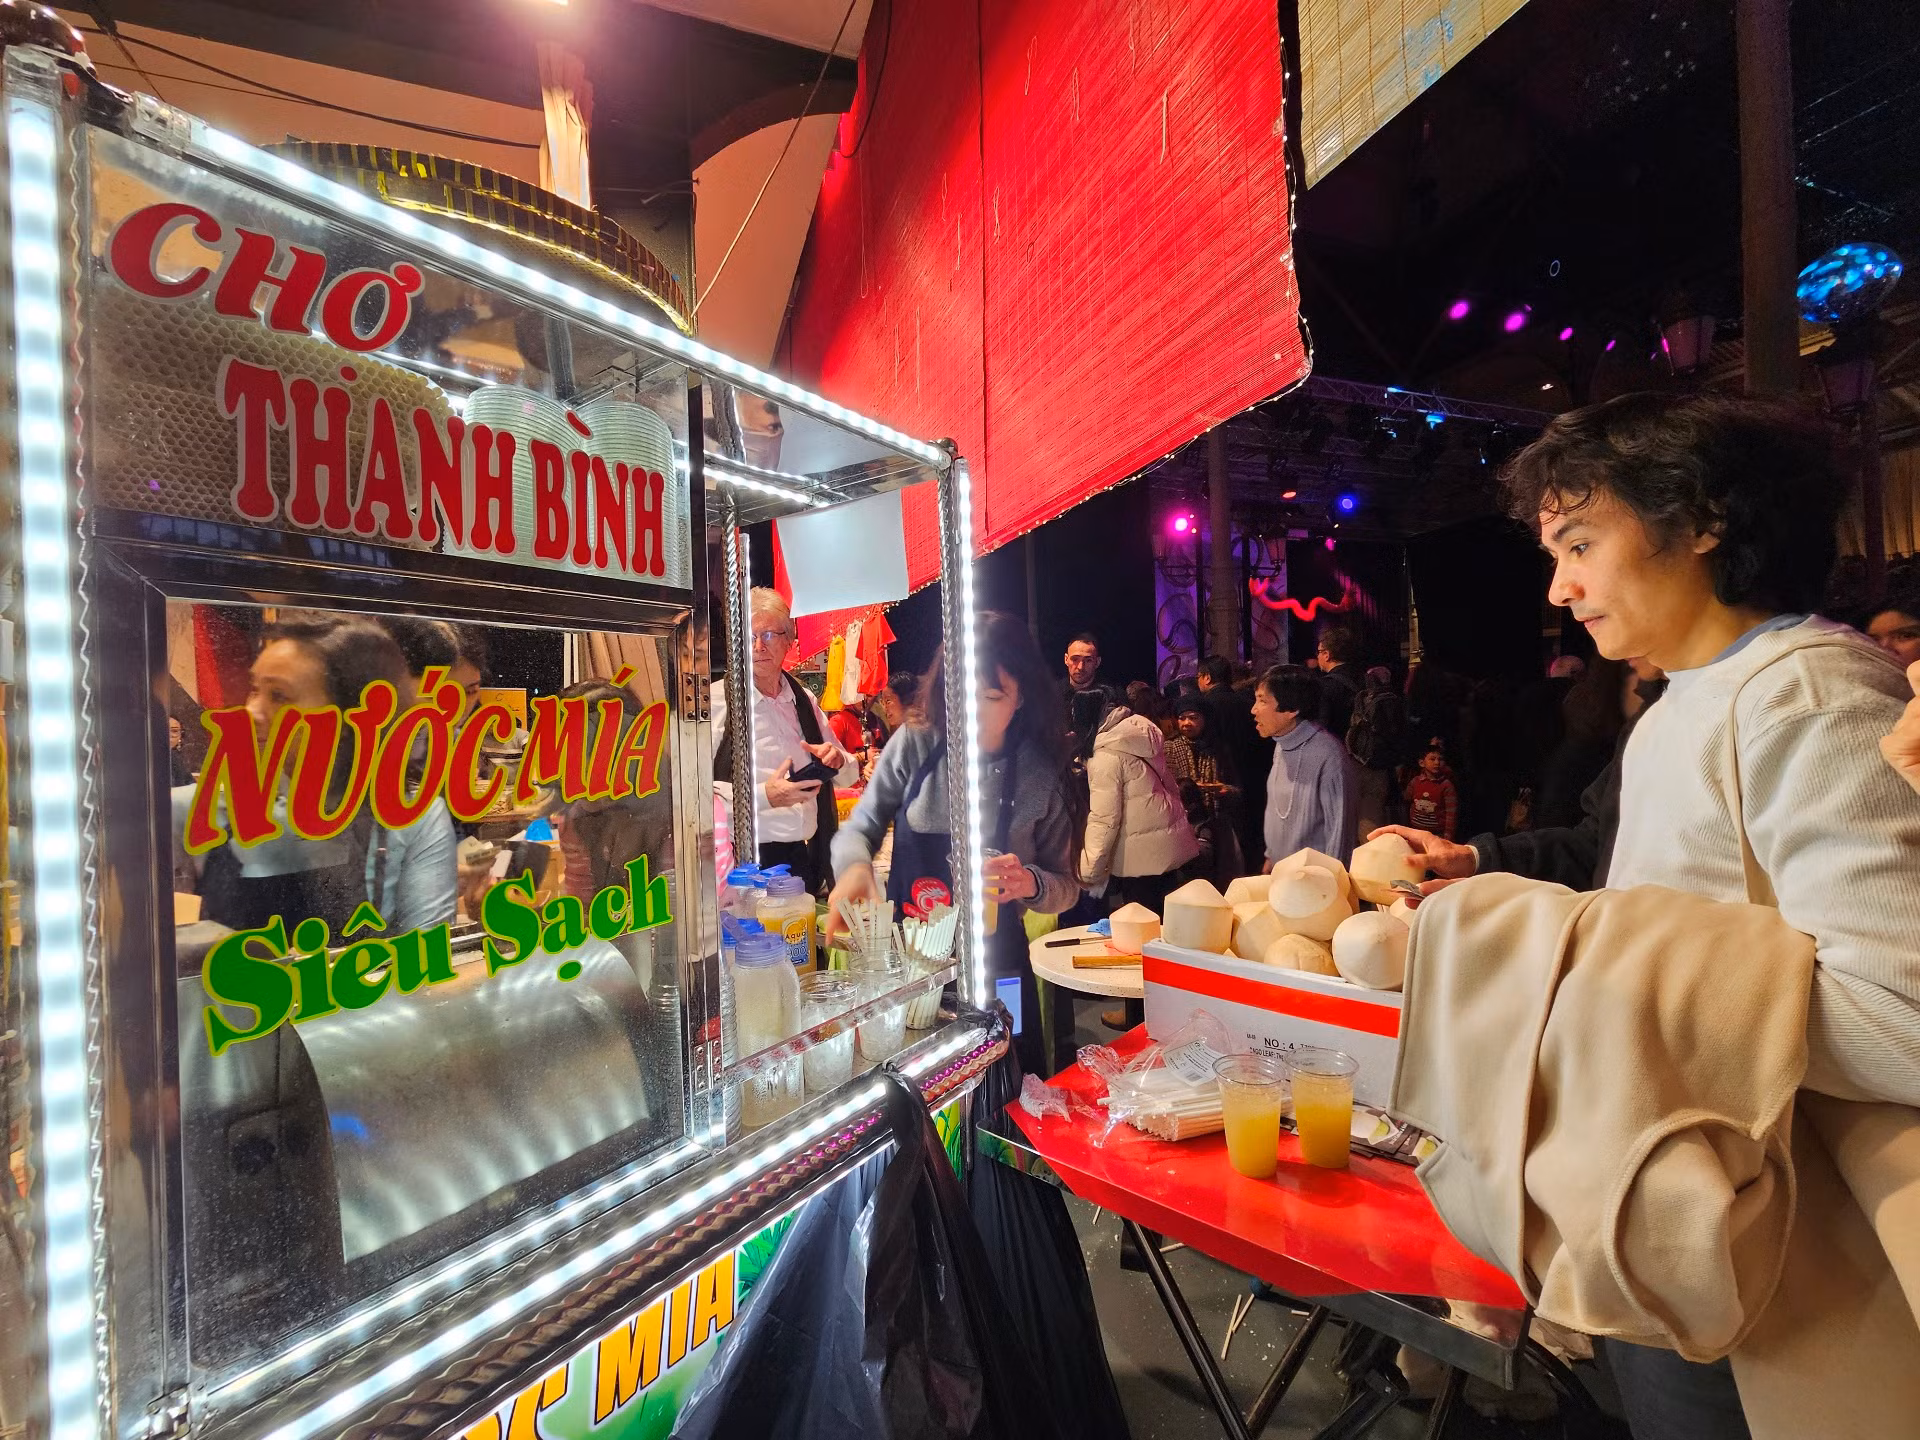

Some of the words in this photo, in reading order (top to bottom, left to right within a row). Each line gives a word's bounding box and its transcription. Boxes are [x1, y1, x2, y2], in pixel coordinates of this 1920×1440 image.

[217, 356, 519, 557] THANH
[528, 409, 668, 579] BÌNH
[185, 666, 519, 855] NƯỚC
[516, 664, 670, 802] MÍA
[202, 901, 459, 1057] Siêu
[482, 854, 673, 982] Sạch
